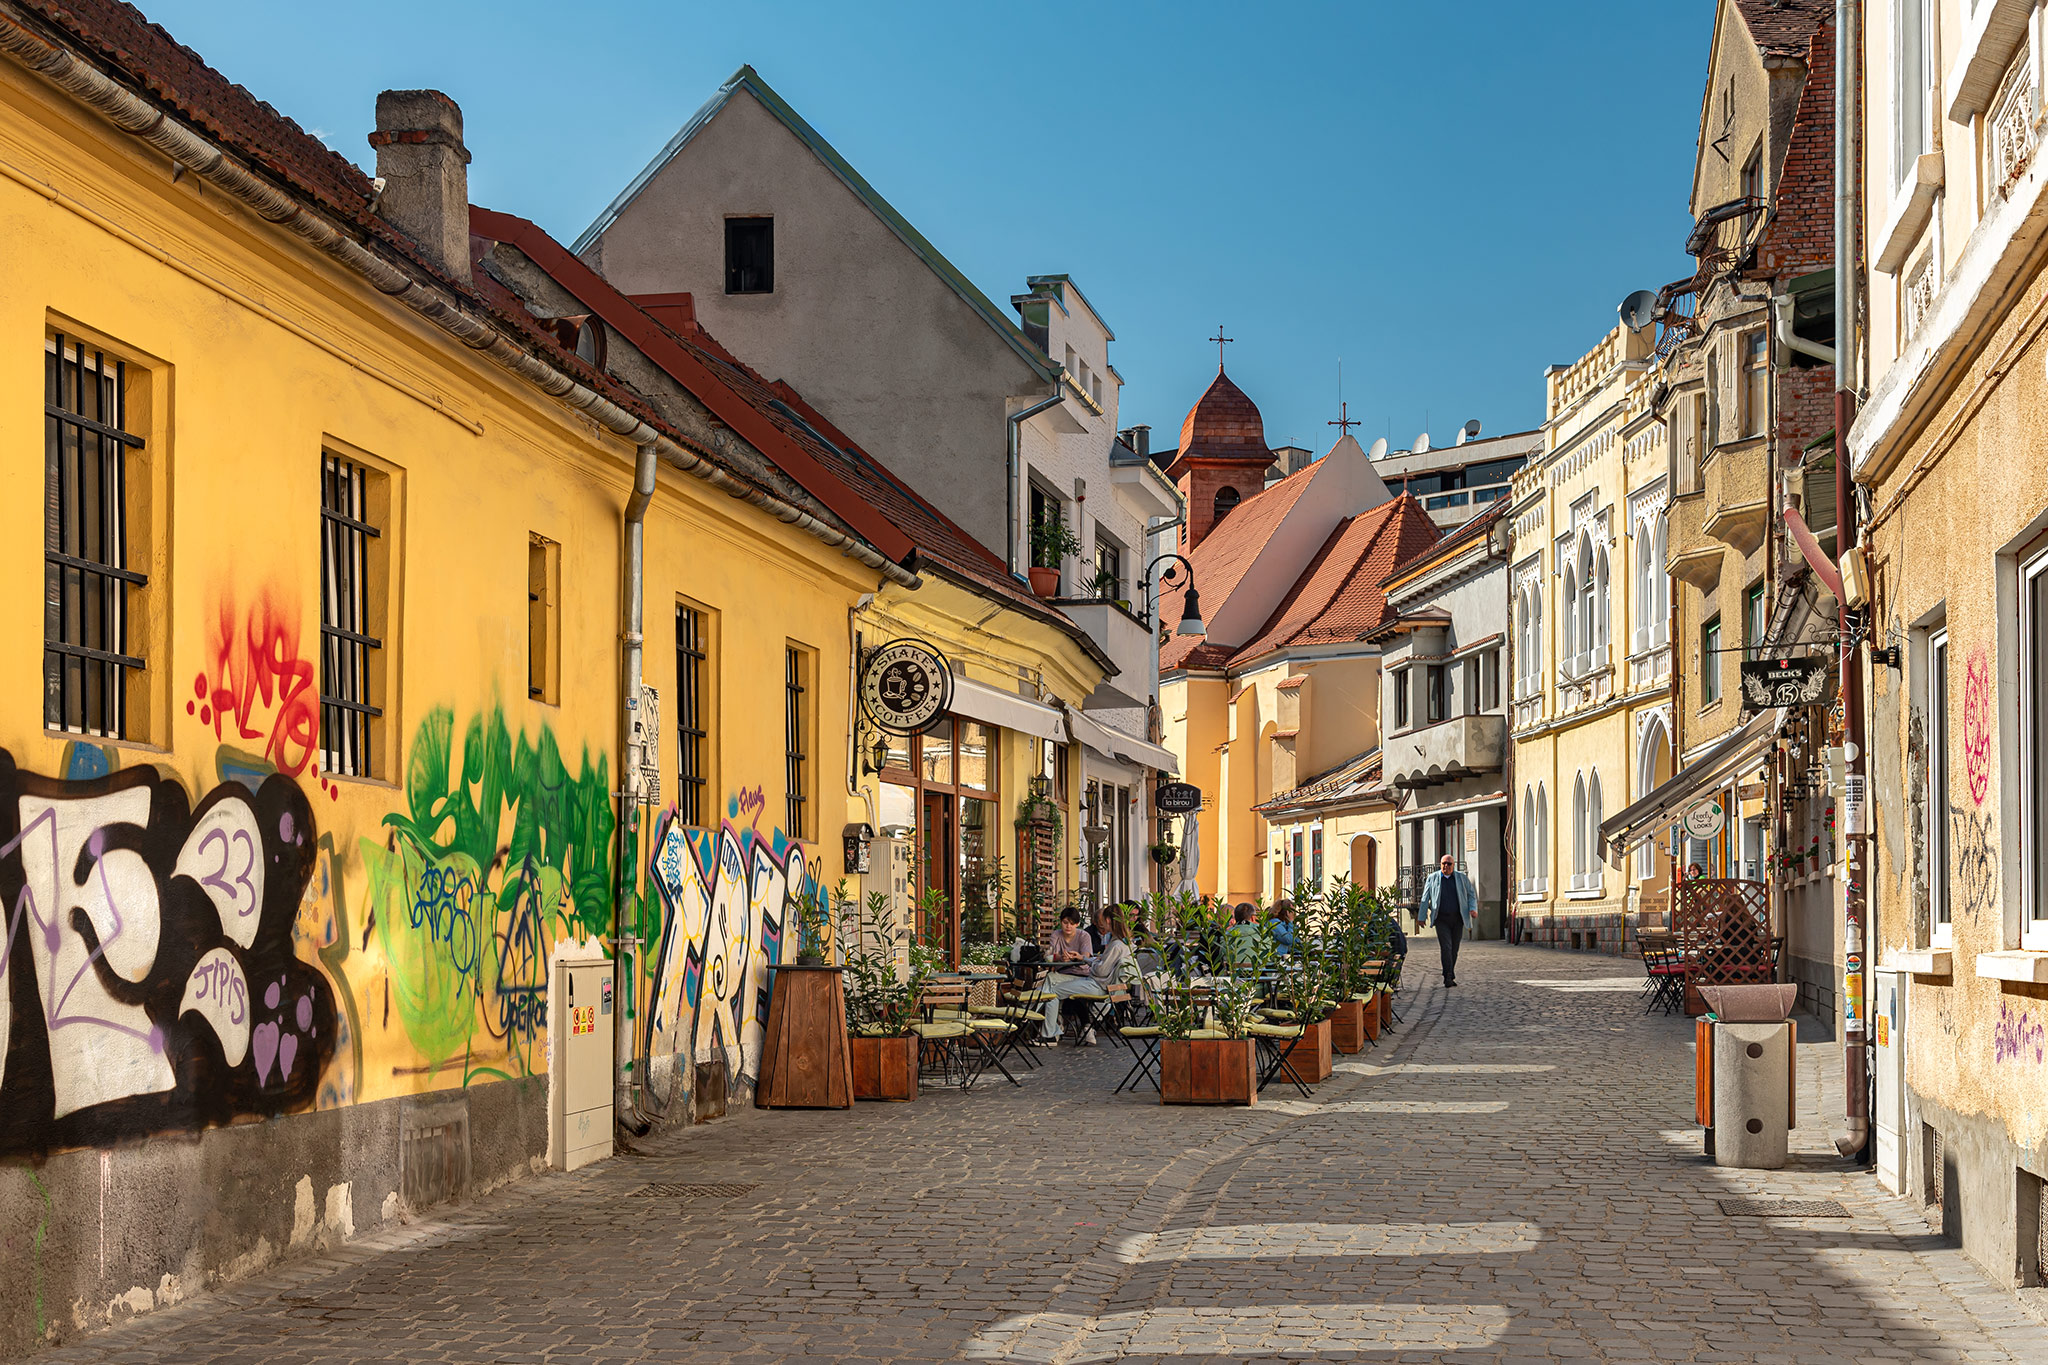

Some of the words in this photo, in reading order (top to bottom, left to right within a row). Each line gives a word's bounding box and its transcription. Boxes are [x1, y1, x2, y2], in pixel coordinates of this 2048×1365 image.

[877, 648, 933, 669] SHAKE
[1768, 669, 1802, 679] BECK'S
[875, 702, 935, 724] COFFEE
[1692, 811, 1713, 823] Lovely
[198, 827, 256, 917] 23
